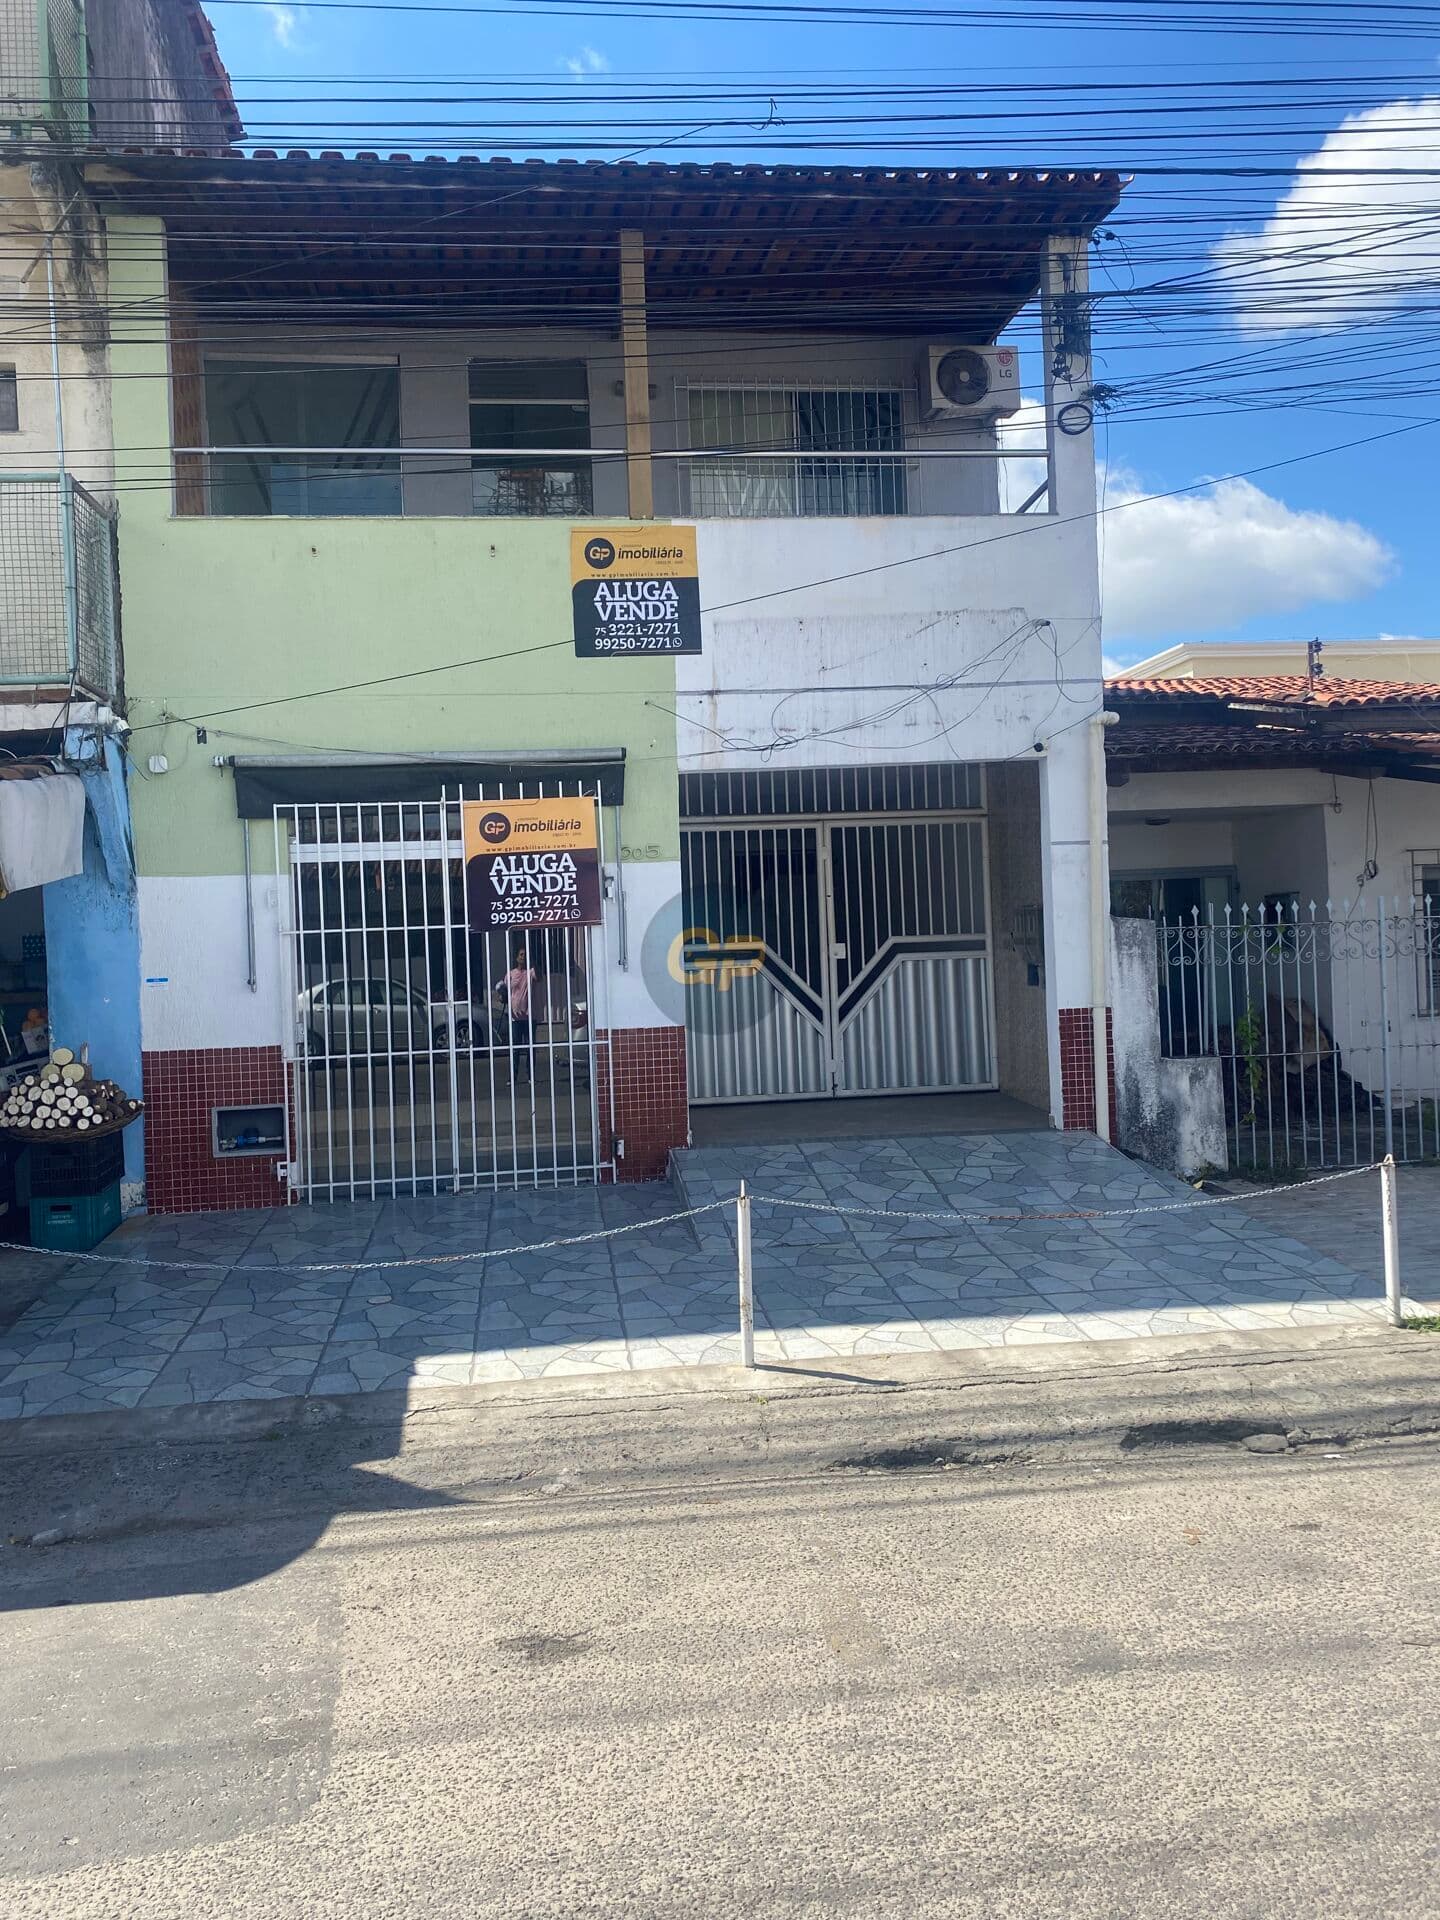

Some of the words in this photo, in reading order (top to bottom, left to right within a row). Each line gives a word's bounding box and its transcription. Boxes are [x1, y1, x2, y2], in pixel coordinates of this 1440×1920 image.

[999, 369, 1012, 378] LG
[590, 547, 611, 561] GP
[618, 547, 684, 560] imobiliária
[593, 580, 680, 601] ALUGA
[594, 600, 679, 621] VENDE
[594, 627, 607, 636] 75
[608, 622, 681, 636] 3221-7271
[594, 637, 672, 650] 99250-7271
[484, 821, 506, 835] GP
[513, 819, 582, 833] imobiliária
[489, 852, 578, 876] ALUGA
[489, 872, 578, 896] VENDE
[490, 901, 503, 911] 75
[504, 894, 579, 910] 3221-7271
[490, 909, 571, 925] 99250-7271
